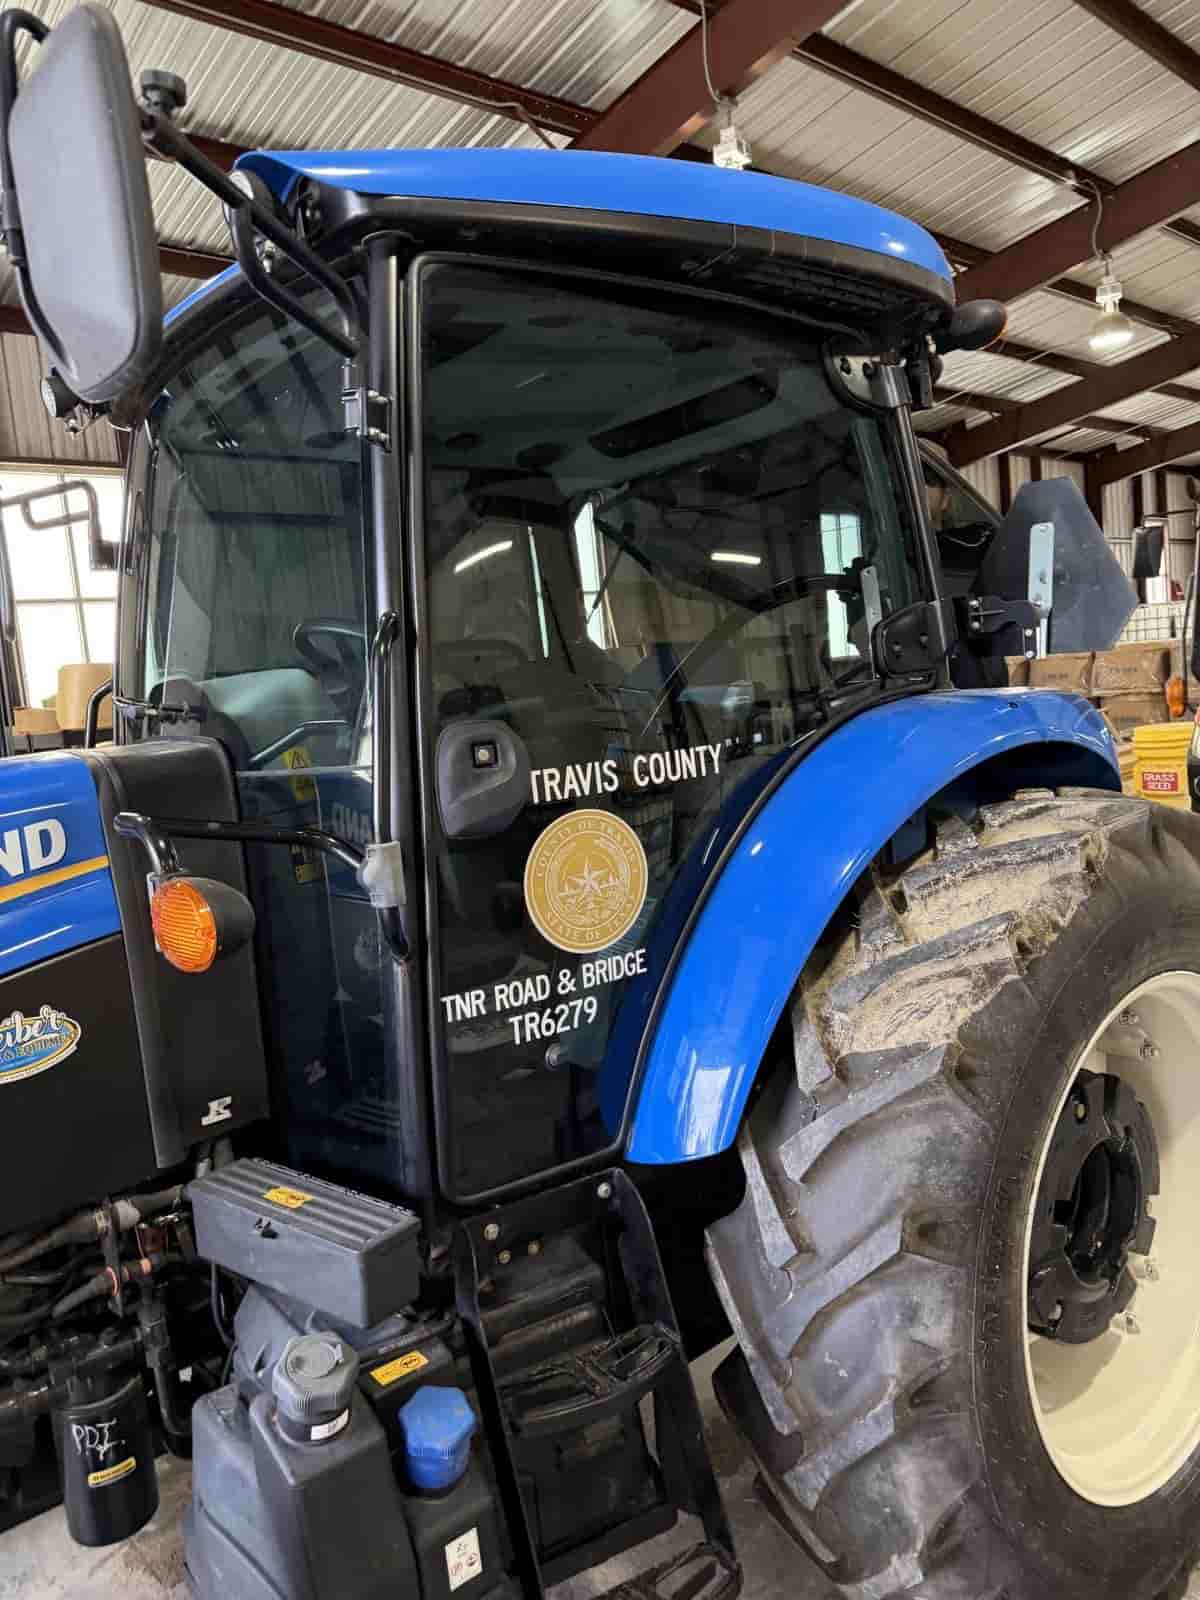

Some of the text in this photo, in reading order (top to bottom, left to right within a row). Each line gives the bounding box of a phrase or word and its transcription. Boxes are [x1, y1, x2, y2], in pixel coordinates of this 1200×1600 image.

[530, 744, 722, 804] TRAVIS COUNTY
[441, 949, 648, 1023] TNR ROAD & BRIDGE
[509, 996, 599, 1046] TR6279
